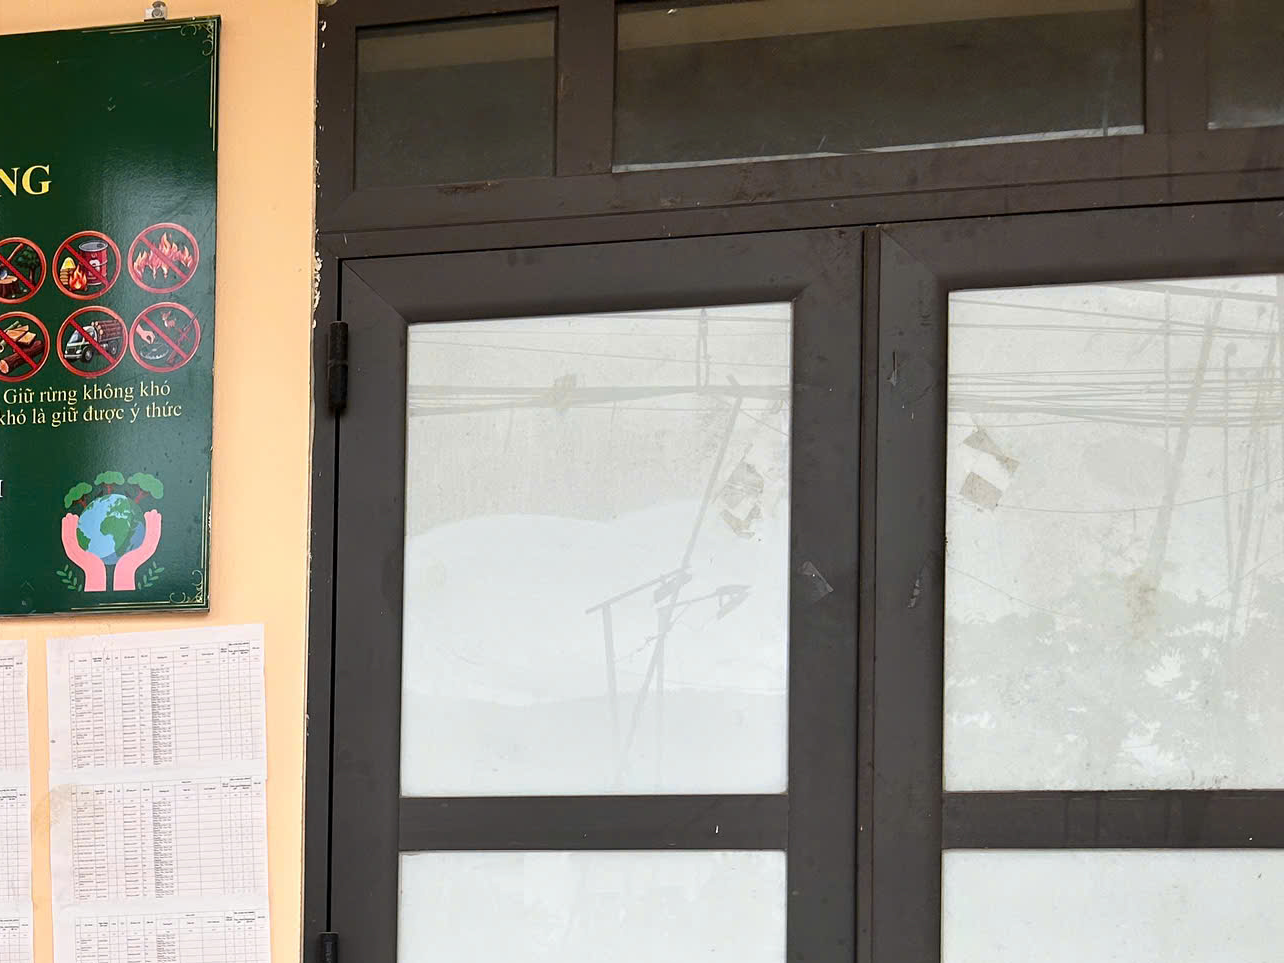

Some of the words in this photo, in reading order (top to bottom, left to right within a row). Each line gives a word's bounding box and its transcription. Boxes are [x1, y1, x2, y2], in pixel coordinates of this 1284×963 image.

[3, 387, 35, 405] Giữ
[39, 386, 78, 406] rừng
[83, 383, 135, 403] không
[139, 379, 171, 397] khó
[32, 408, 46, 424] là
[51, 406, 79, 428] giữ
[83, 405, 125, 424] được
[129, 402, 141, 424] ý
[146, 401, 182, 418] thức
